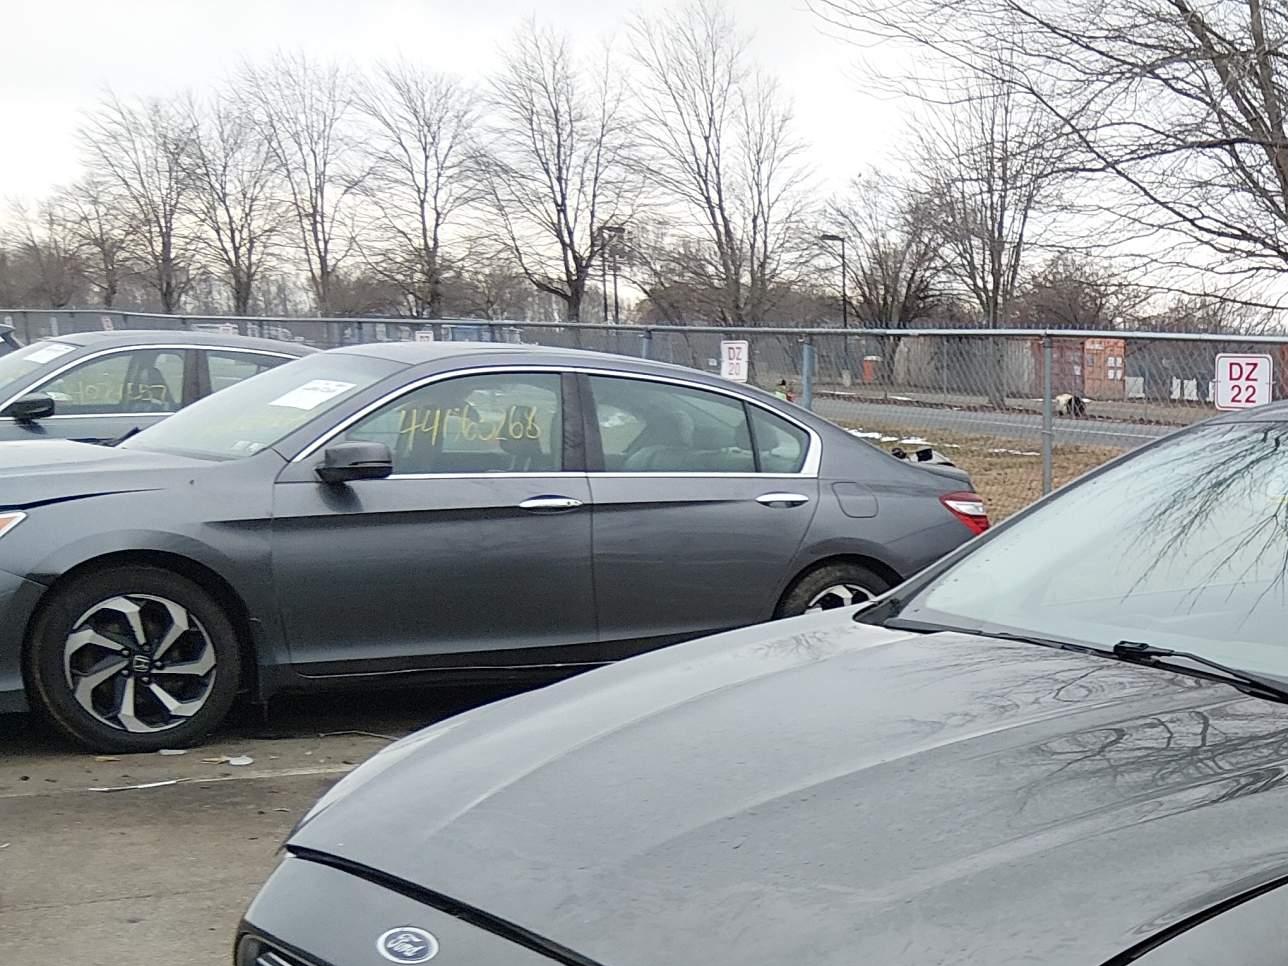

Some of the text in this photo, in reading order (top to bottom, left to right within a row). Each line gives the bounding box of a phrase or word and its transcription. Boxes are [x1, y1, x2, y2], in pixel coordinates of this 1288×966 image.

[728, 347, 742, 361] DZ
[1229, 362, 1258, 382] DZ
[1230, 384, 1257, 404] 22
